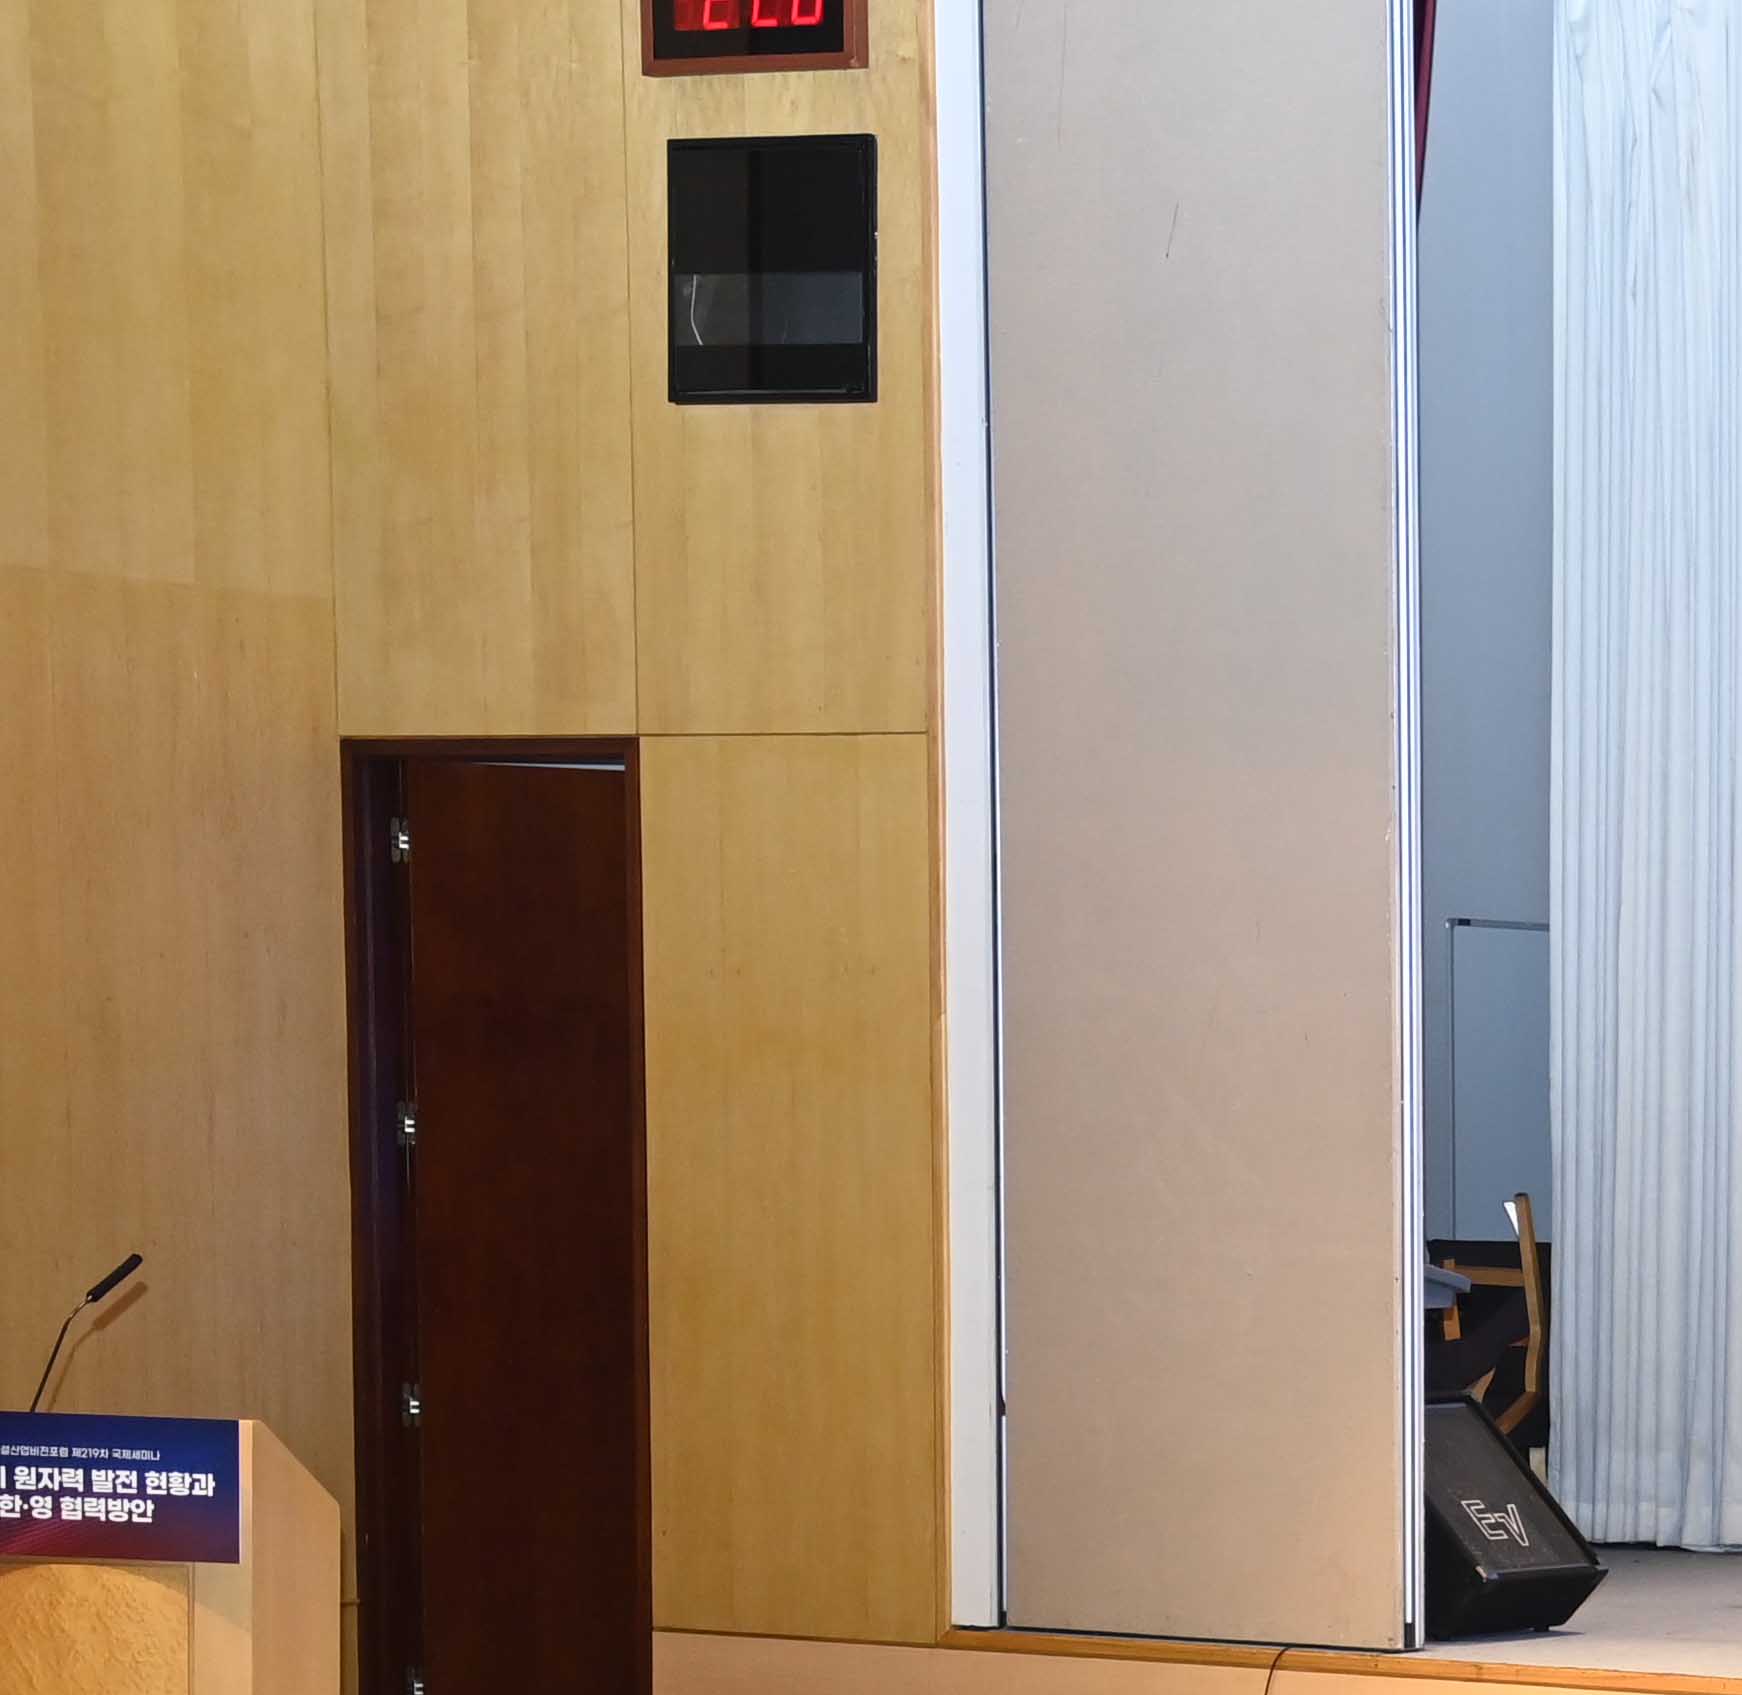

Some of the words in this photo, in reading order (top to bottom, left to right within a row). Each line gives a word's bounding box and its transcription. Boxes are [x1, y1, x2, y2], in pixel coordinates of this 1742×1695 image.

[72, 1447, 109, 1460] 제219차
[112, 1448, 160, 1461] 국제세미나
[13, 1465, 84, 1492] 원자력
[91, 1469, 138, 1494] 발전
[144, 1471, 216, 1497] 현황과
[60, 1496, 155, 1523] 협력방안
[1460, 1499, 1530, 1547] EV
